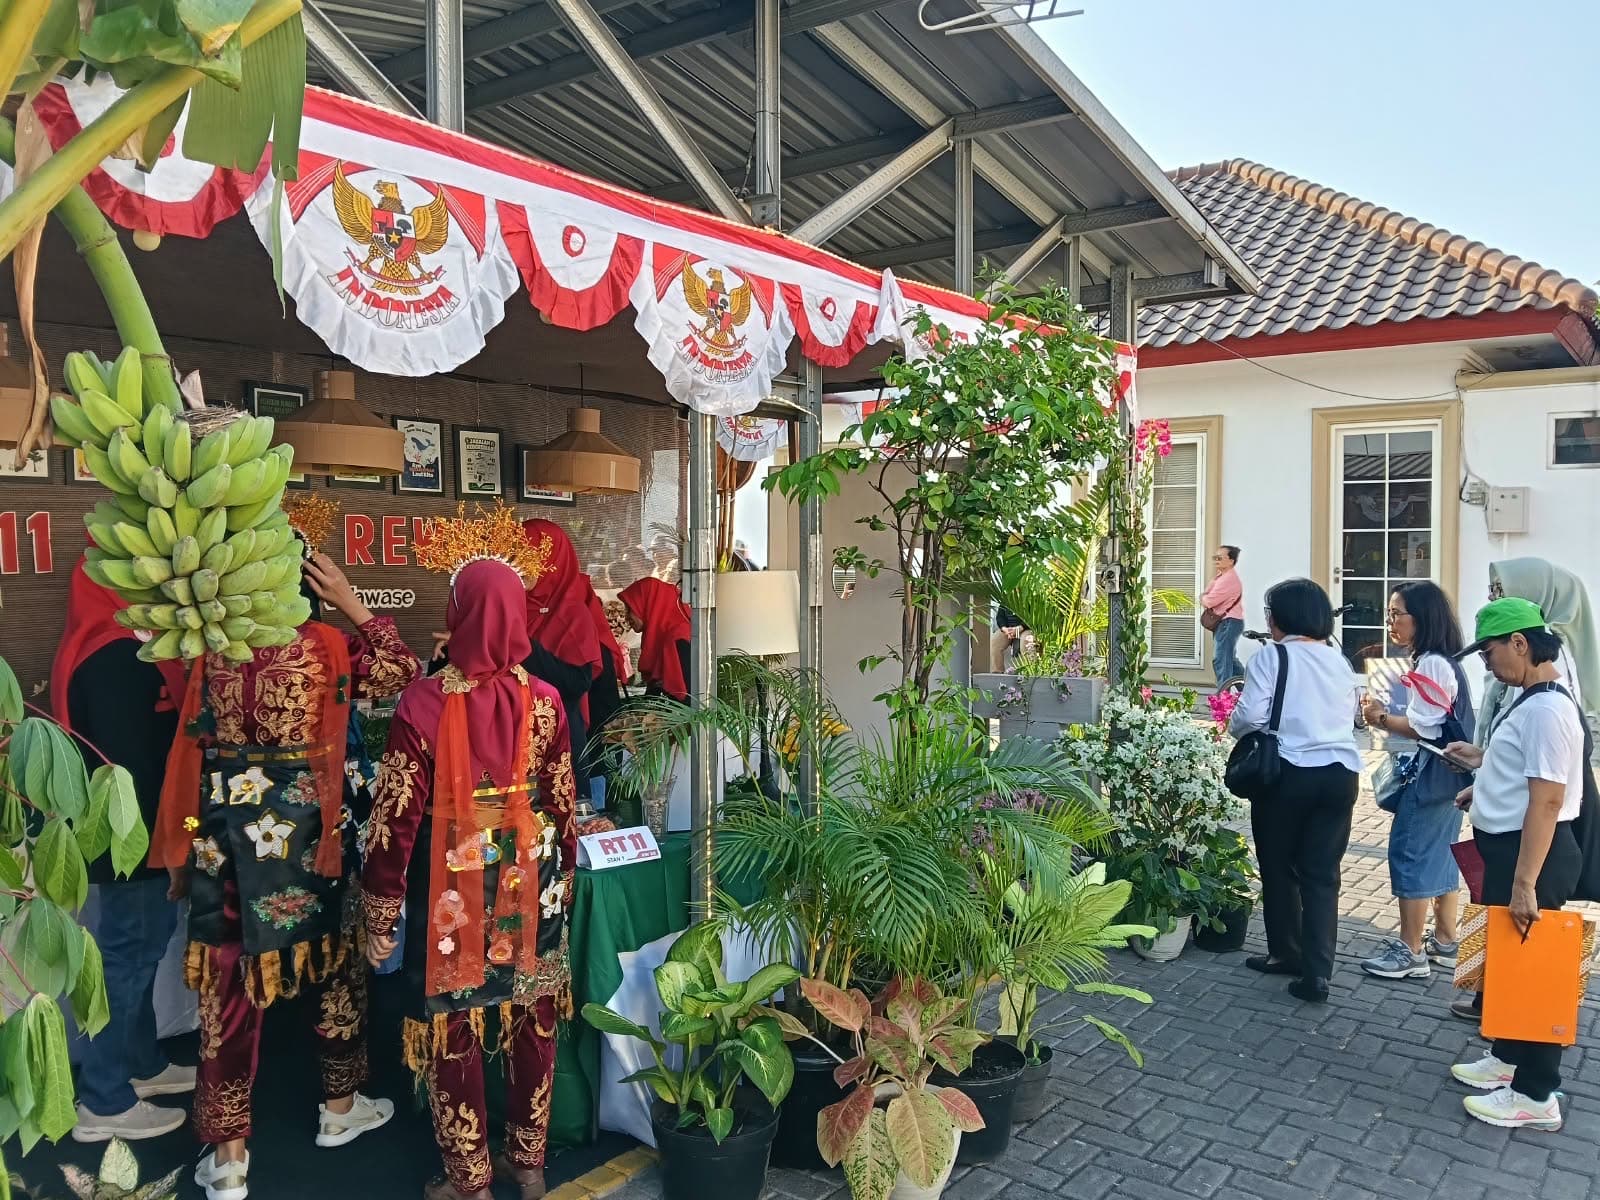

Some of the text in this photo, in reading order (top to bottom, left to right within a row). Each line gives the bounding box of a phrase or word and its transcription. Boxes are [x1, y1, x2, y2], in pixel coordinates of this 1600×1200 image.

[327, 265, 461, 330] INDONESIA
[676, 334, 759, 383] INDONESIA
[598, 836, 627, 855] RT
[627, 832, 647, 850] 11
